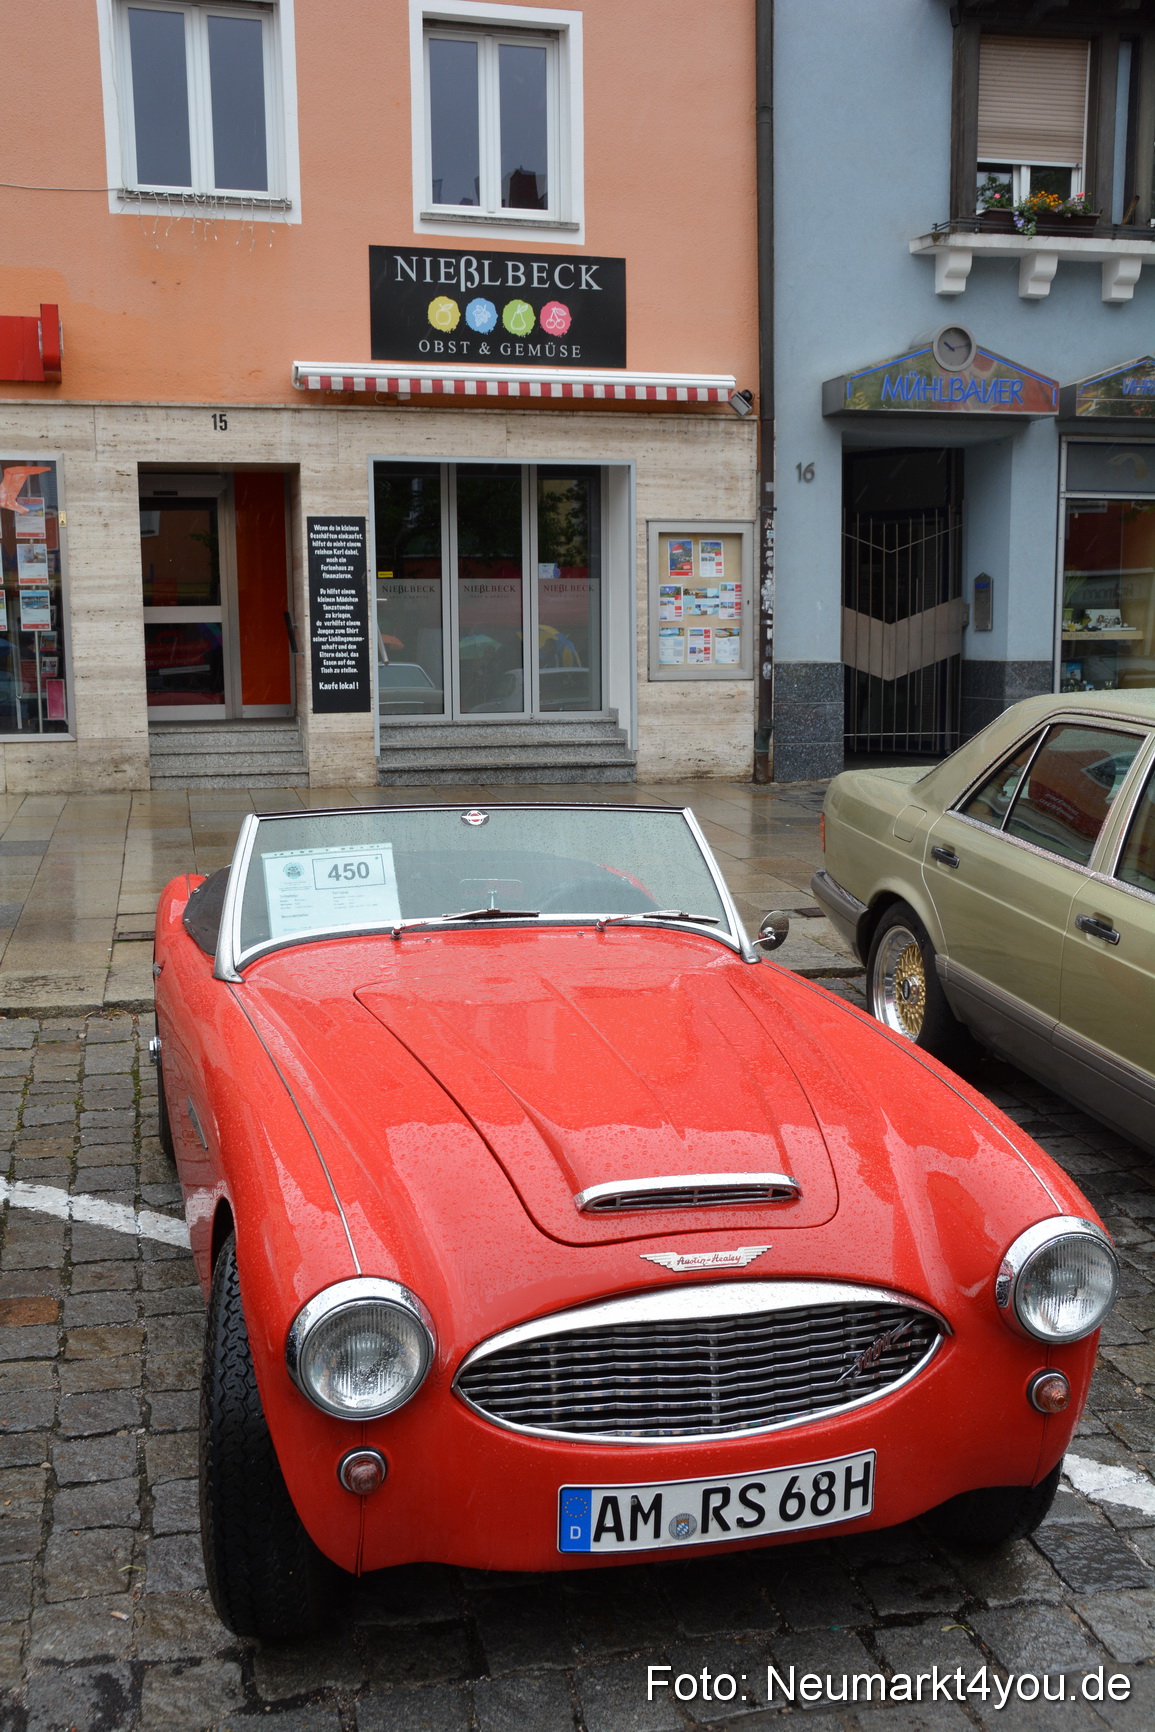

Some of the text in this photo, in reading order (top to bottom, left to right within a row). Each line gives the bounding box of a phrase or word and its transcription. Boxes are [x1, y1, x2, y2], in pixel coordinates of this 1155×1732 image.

[394, 255, 603, 292] NIEßLBECK
[418, 340, 581, 358] OBST & GEMÜSE
[880, 372, 1025, 404] MÜHLBAUER
[211, 413, 228, 431] 15
[796, 462, 815, 483] 16
[382, 584, 435, 594] NIEßLBECK
[463, 584, 516, 594] NIEßLBECK
[327, 861, 370, 881] 450
[677, 1253, 742, 1266] Austin-Healey
[592, 1492, 663, 1542] AM
[700, 1481, 767, 1534] RS
[778, 1460, 872, 1522] 68H
[569, 1525, 582, 1540] D
